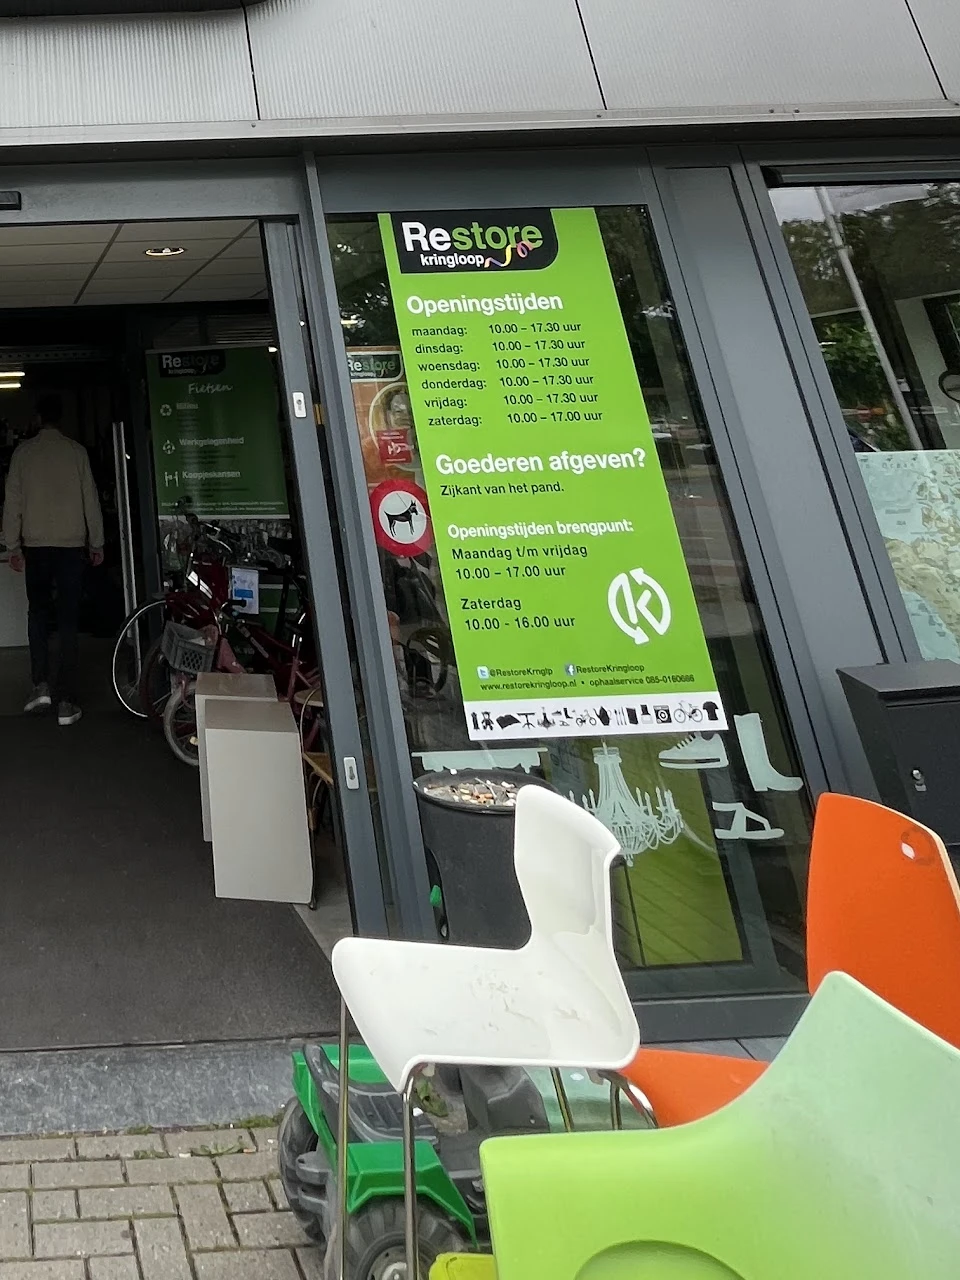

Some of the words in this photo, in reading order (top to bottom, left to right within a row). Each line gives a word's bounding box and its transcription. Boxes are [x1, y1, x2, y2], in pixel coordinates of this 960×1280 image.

[401, 222, 543, 251] Restore
[420, 253, 484, 268] kringloop
[407, 293, 563, 317] Openingstijden
[412, 327, 467, 337] maandag:
[488, 324, 518, 334] 10.00
[531, 322, 559, 333] 17.30
[415, 344, 463, 355] dinsdag:
[492, 341, 522, 352] 10.00
[535, 340, 564, 350] 17.30
[567, 341, 585, 349] uur
[418, 361, 480, 372] woensdag:
[496, 359, 526, 369] 10.00
[538, 357, 568, 368] 17.30
[571, 358, 590, 366] uur
[421, 379, 487, 390] donderdag:
[500, 377, 529, 387] 10.00
[542, 375, 572, 385] 17.30
[575, 376, 594, 384] uur
[424, 397, 467, 409] vrijdag:
[503, 394, 533, 405] 10.00
[546, 393, 576, 403] 17.30
[580, 394, 598, 402] uur
[428, 415, 482, 427] zaterdag:
[507, 413, 537, 423] 10.00
[550, 411, 580, 422] 17.00
[584, 412, 602, 420] uur
[435, 453, 543, 475] Goederen
[549, 448, 646, 474] afgeven?
[440, 484, 482, 497] Zijkant
[484, 485, 506, 494] van
[508, 483, 528, 493] het
[531, 481, 564, 494] pand.
[447, 521, 554, 540] Openingstijden
[557, 519, 634, 535] brengpunt:
[452, 547, 512, 561] Maandag
[516, 546, 538, 557] t/m
[542, 544, 588, 559] vrijdag
[456, 568, 490, 579] 10.00
[506, 566, 540, 577] 17.00
[544, 567, 566, 576] uur
[461, 598, 521, 611] Zaterdag
[465, 619, 500, 630] 10.00
[515, 617, 549, 628] 16.00
[554, 617, 575, 627] uur
[576, 664, 644, 674] RestoreKringloop
[481, 679, 577, 690] www.restorekringloop.nl
[589, 677, 644, 688] ophaalservice
